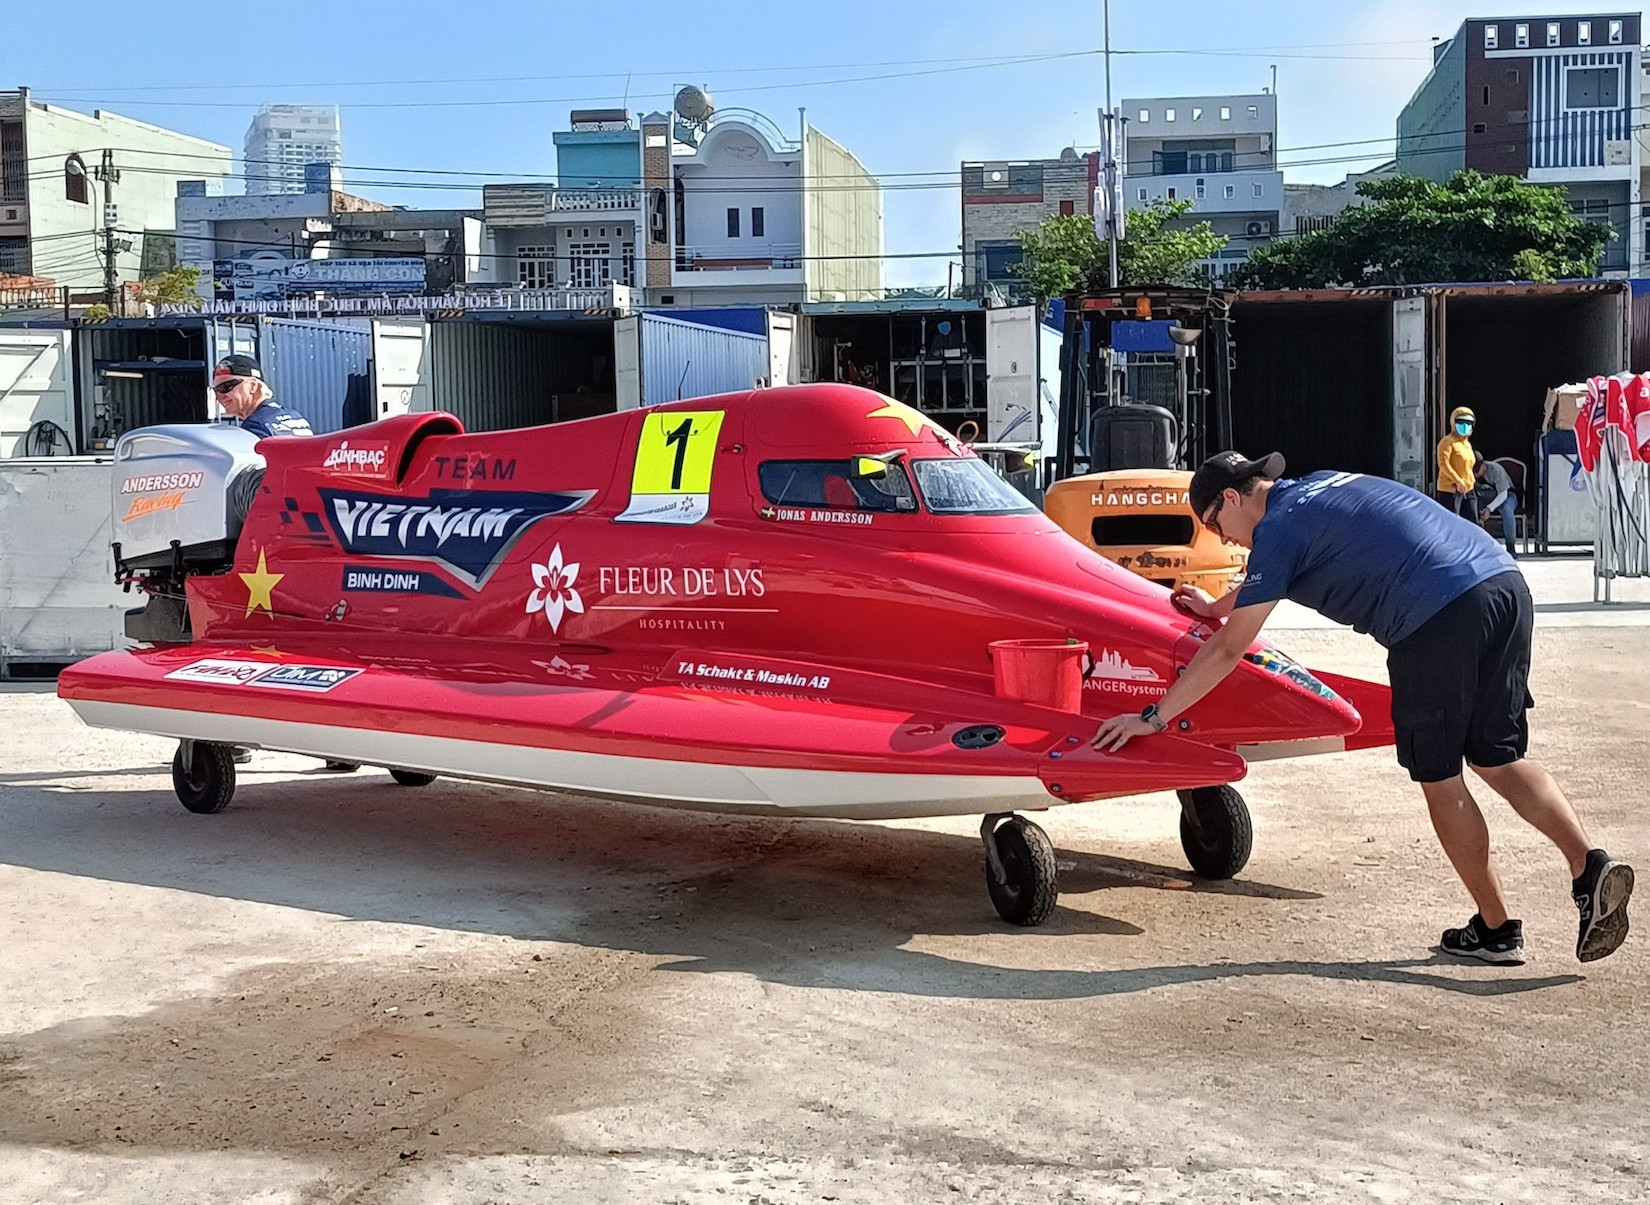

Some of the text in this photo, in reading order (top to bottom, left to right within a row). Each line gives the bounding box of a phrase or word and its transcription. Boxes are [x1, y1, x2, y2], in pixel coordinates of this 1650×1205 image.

[665, 418, 693, 490] 1
[435, 456, 517, 481] TEAM
[120, 472, 204, 494] ANDERSSON
[1091, 491, 1191, 506] HANGCHA
[332, 498, 525, 550] VIETNAM
[776, 509, 874, 525] JONAS ANDERSSON
[347, 572, 420, 590] BINH DINH
[599, 567, 766, 598] FLEUR DE LYS
[639, 618, 726, 631] HOSPITALITY
[677, 661, 695, 676] TA
[695, 663, 743, 681] Schakt
[743, 668, 755, 682] &
[755, 670, 807, 688] Maskin
[807, 676, 831, 690] AB
[1082, 679, 1168, 697] ANGERsystem
